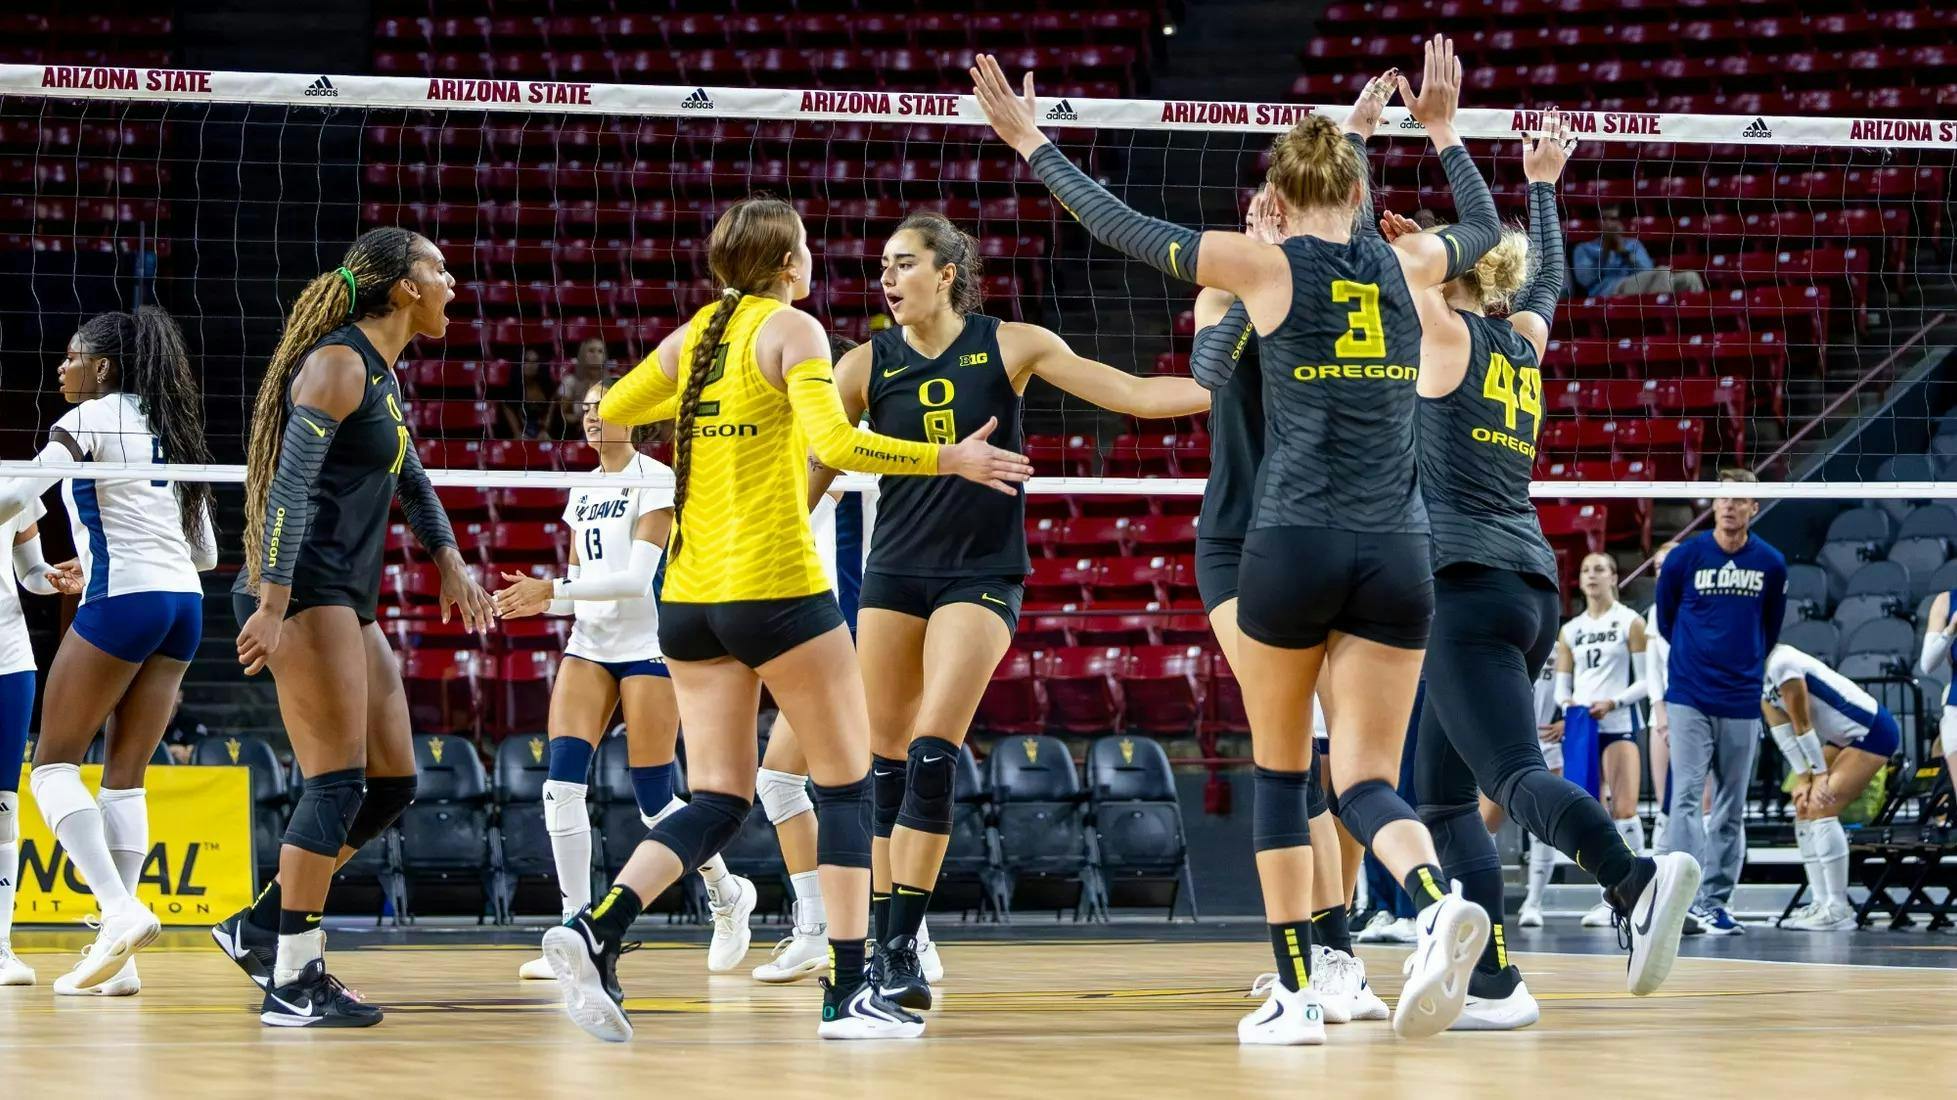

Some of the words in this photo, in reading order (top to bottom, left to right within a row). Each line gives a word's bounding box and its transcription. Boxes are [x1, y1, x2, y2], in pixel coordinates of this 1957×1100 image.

[42, 66, 138, 91] ARIZONA
[146, 69, 212, 93] STATE
[304, 87, 338, 97] adidas
[426, 78, 521, 103] ARIZONA
[527, 82, 592, 105] STATE
[681, 99, 714, 110] adidas
[800, 90, 891, 114] ARIZONA
[898, 93, 960, 116] STATE
[1161, 102, 1249, 124] ARIZONA
[1046, 111, 1078, 121] adidas
[1511, 110, 1597, 133] ARINA
[1603, 112, 1661, 135] STATE
[1743, 129, 1772, 138] adidas
[1850, 120, 1933, 141] ARIZONA
[1331, 280, 1387, 358] 3
[1231, 321, 1253, 360] OREG
[1483, 352, 1542, 442] 44
[1472, 427, 1537, 461] OREGO
[585, 527, 603, 560] 13
[1694, 569, 1717, 590] UC
[1717, 568, 1765, 592] DAVIS
[1586, 648, 1602, 669] 12
